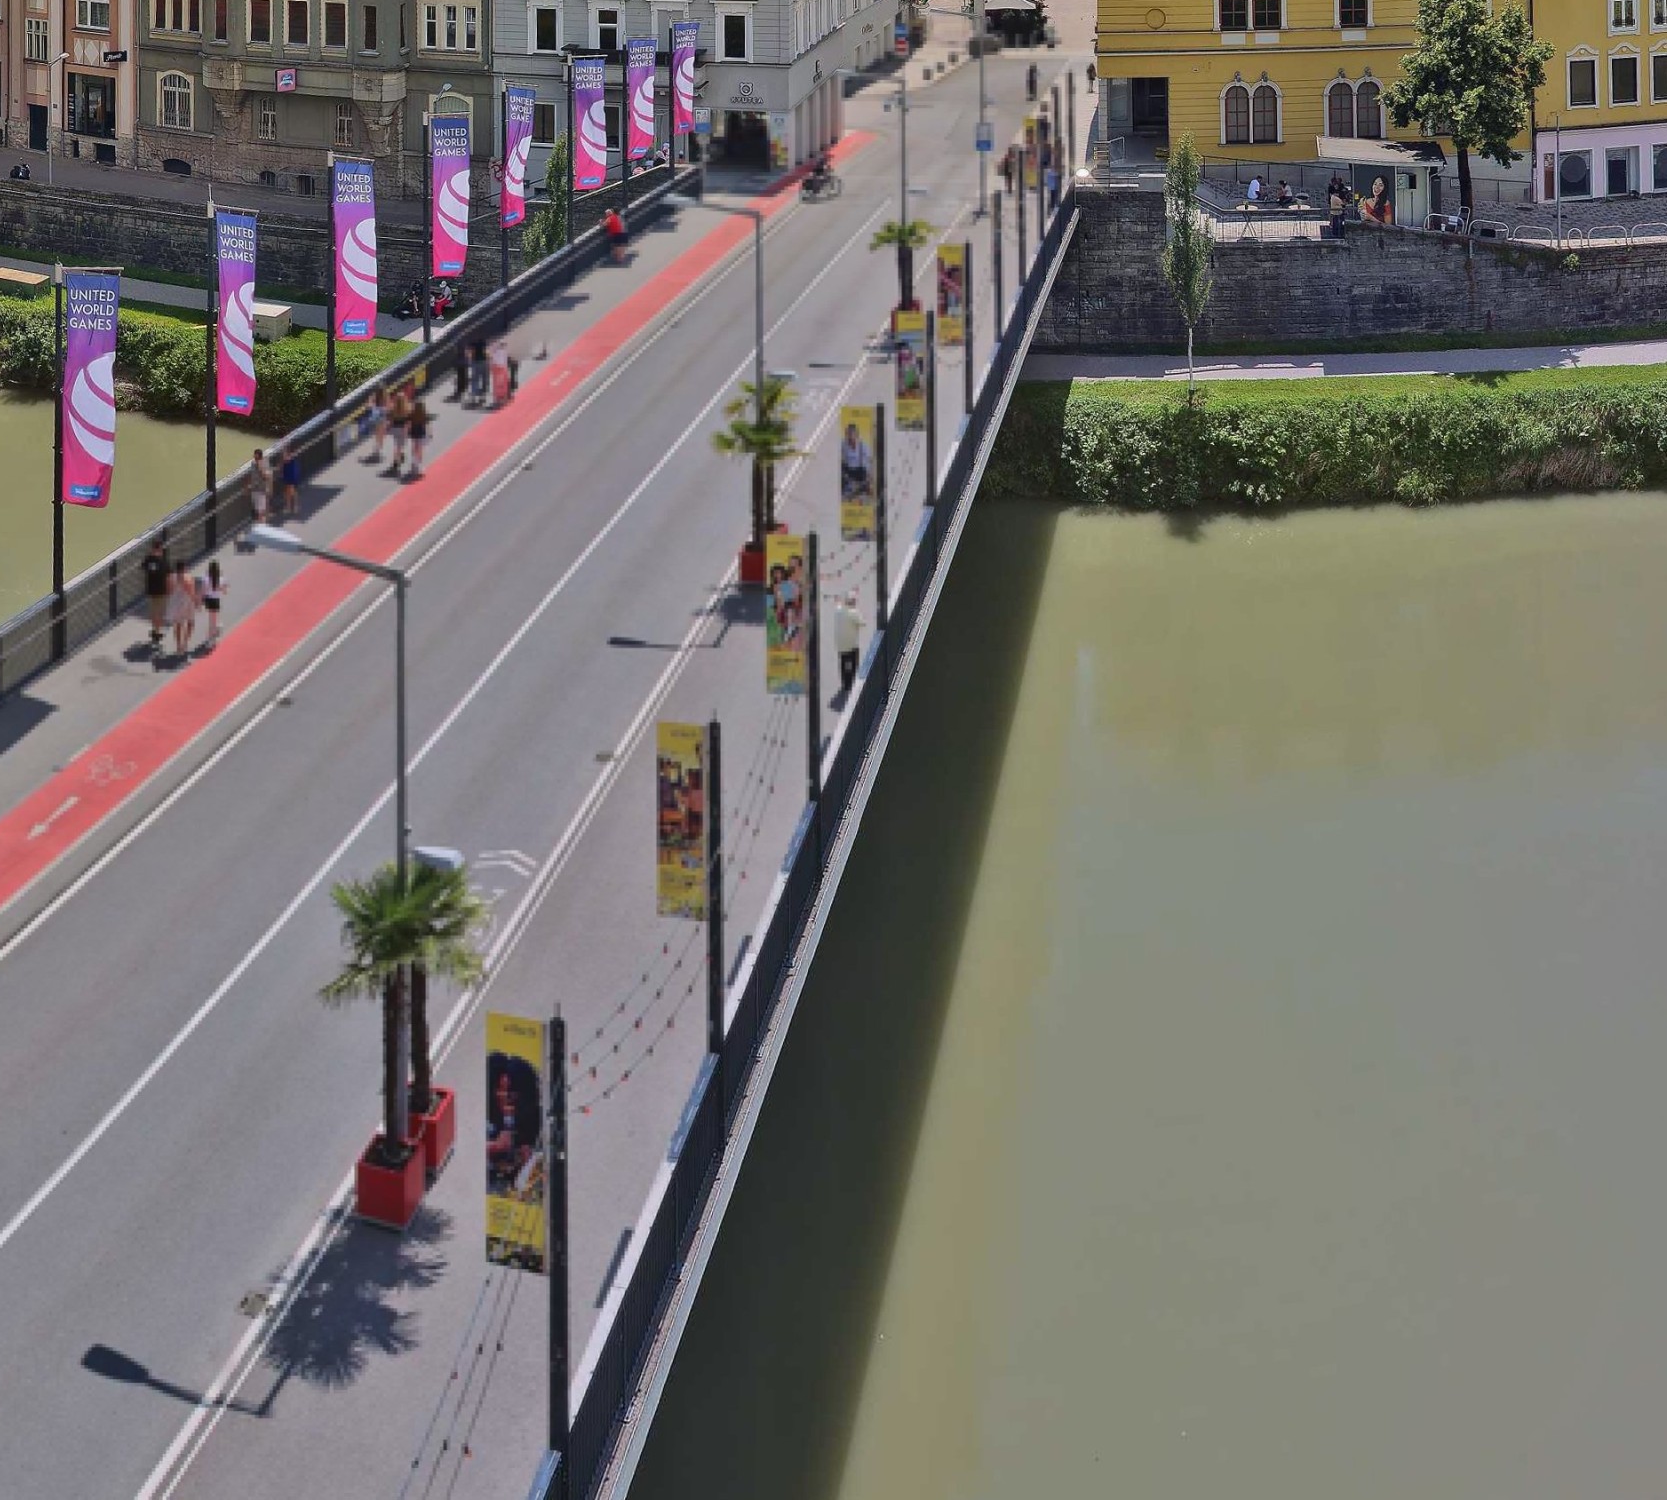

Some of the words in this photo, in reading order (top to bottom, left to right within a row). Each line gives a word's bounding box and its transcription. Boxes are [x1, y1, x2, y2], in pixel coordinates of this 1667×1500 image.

[629, 45, 655, 54] UNITED
[629, 52, 654, 61] WORLD
[629, 60, 653, 69] GAMES
[575, 66, 603, 74] UNITED
[575, 74, 603, 82] WORLD
[575, 81, 602, 89] GAMES
[510, 112, 530, 123] GAME
[434, 128, 467, 137] UNITED
[434, 138, 467, 147] WORLD
[434, 148, 467, 157] GAMES
[337, 172, 371, 184] UNITED
[337, 183, 372, 194] WORLD
[336, 194, 371, 204] GAMES
[220, 224, 254, 239] UNITED
[220, 236, 255, 251] WORLD
[220, 249, 254, 264] GAMES
[70, 289, 115, 302] UNITED
[70, 303, 114, 317] WORLD
[69, 317, 112, 331] GAMES
